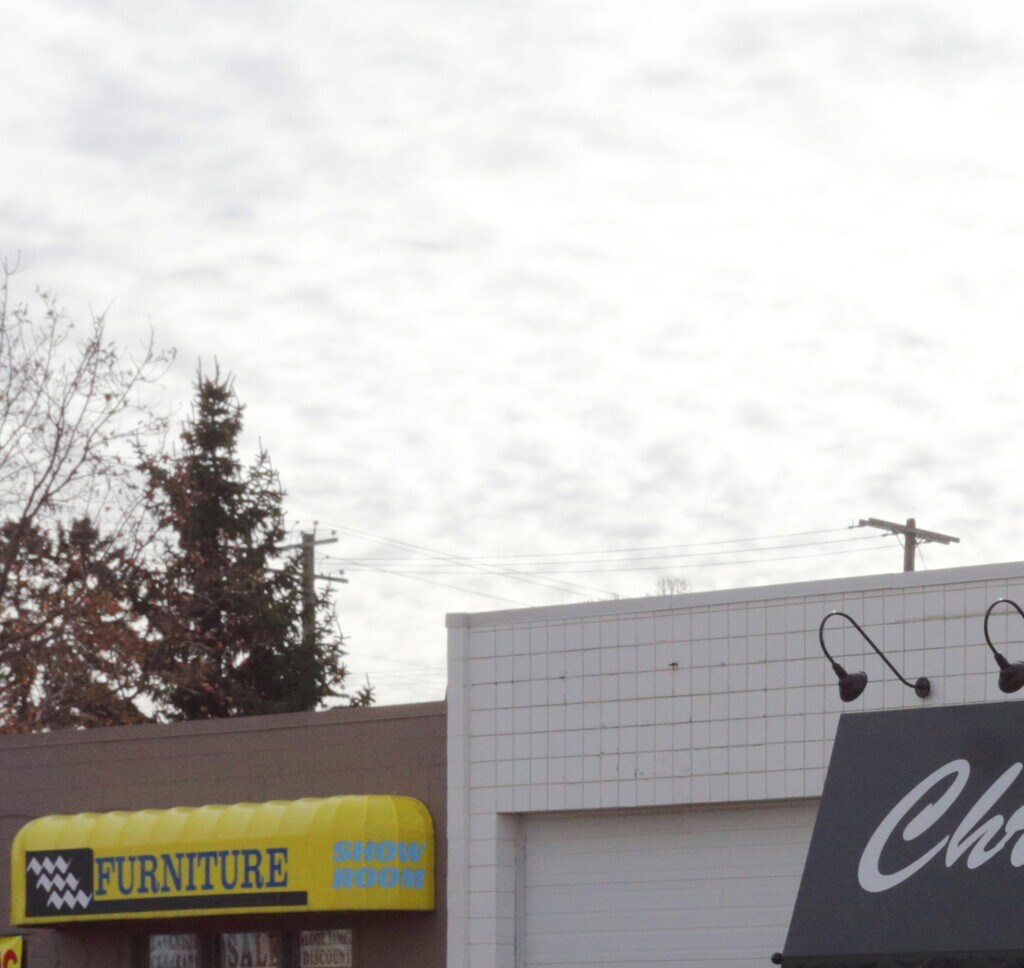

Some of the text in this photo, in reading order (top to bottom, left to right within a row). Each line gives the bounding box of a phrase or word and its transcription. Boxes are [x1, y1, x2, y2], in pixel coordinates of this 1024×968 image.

[333, 840, 427, 862] SHOW
[95, 848, 288, 896] FURNITURE
[332, 867, 426, 889] ROOM
